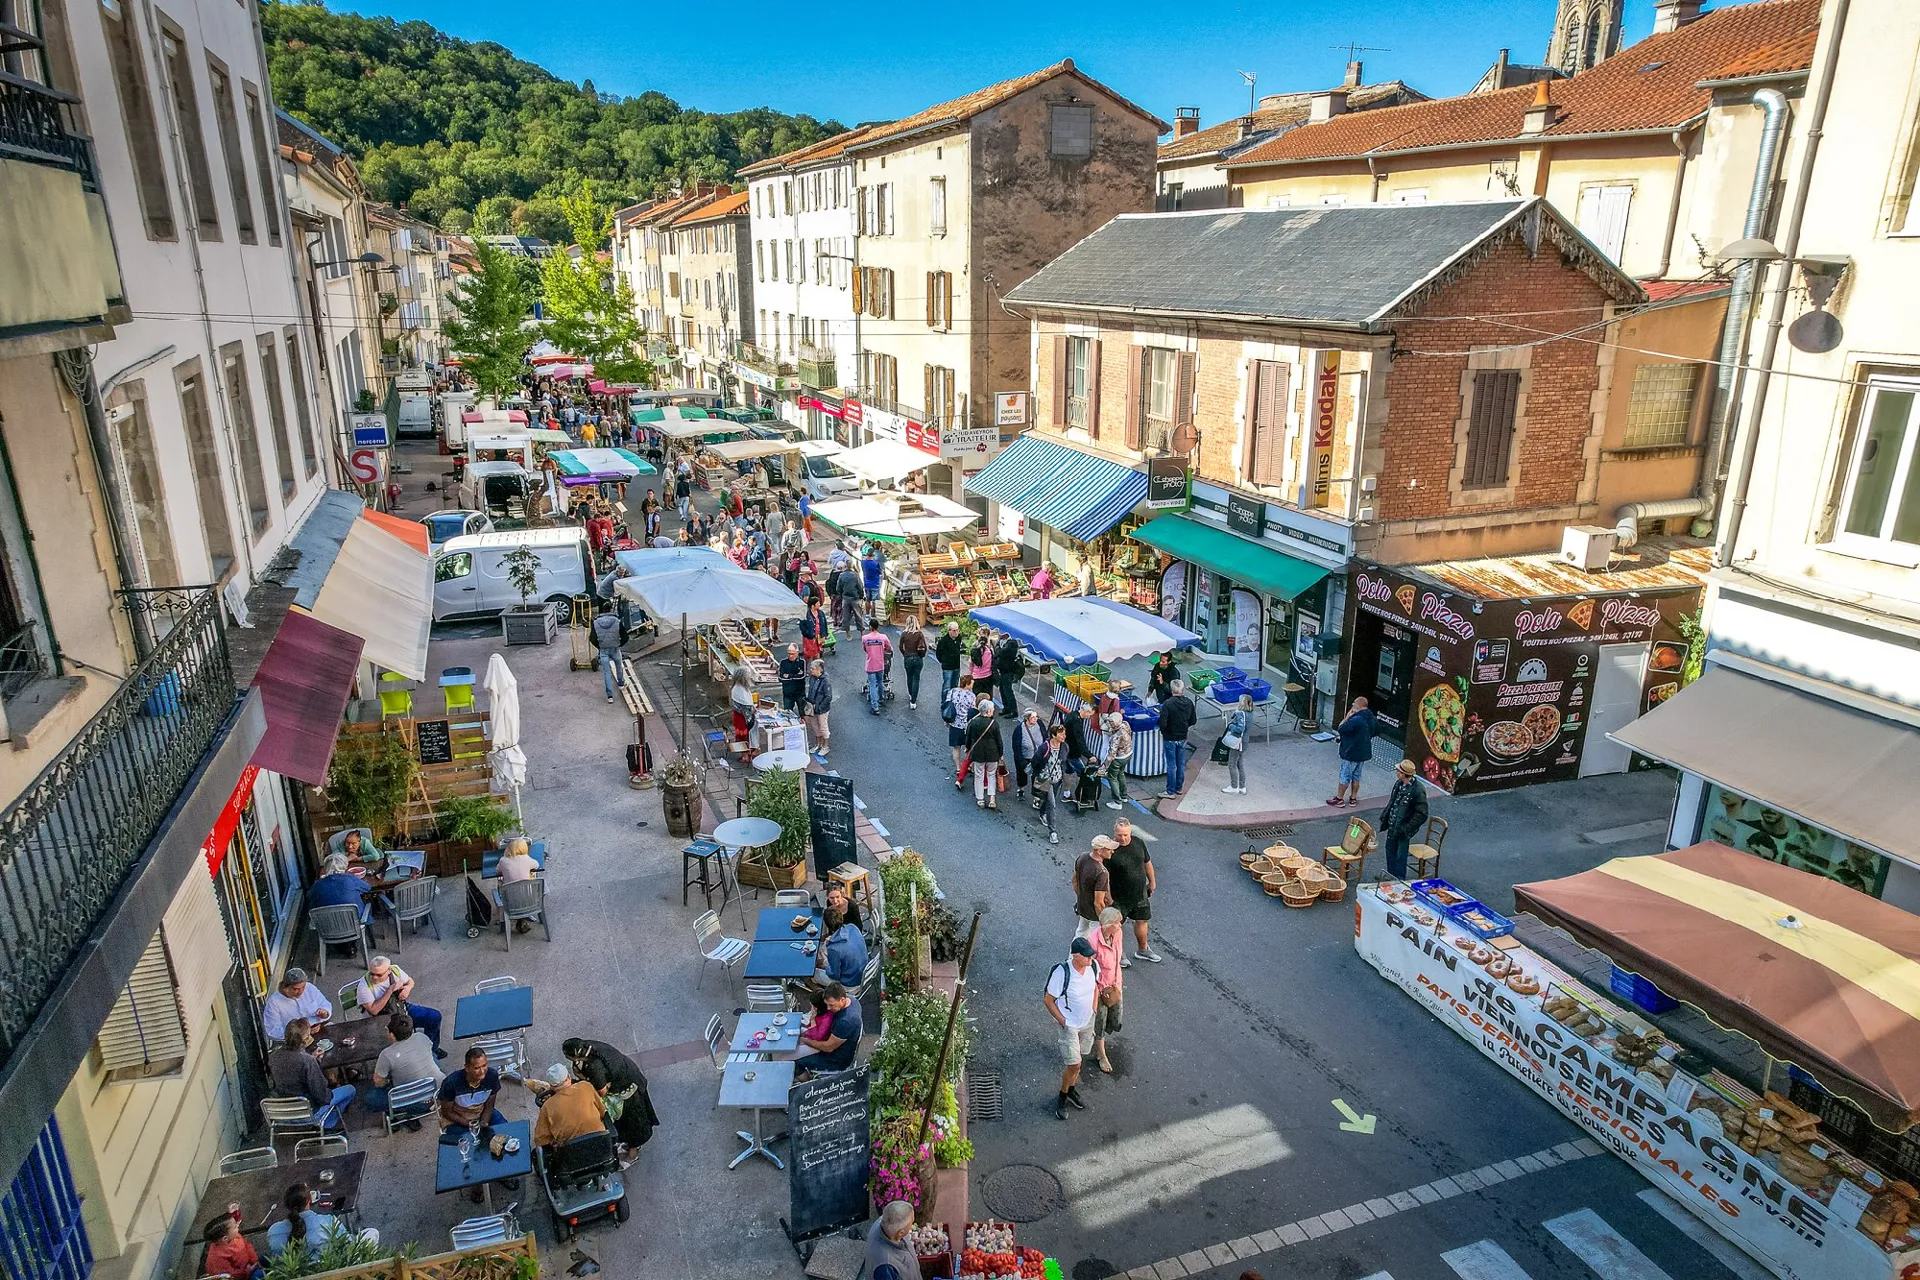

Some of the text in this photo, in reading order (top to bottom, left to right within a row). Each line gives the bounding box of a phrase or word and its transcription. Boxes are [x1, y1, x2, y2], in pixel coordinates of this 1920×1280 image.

[1314, 364, 1337, 448] Kodak
[957, 434, 997, 443] TRAITEUR
[351, 449, 377, 483] S
[1315, 453, 1330, 497] films
[1266, 524, 1282, 532] PHOTO
[1356, 574, 1474, 640] Pola Pizza
[1361, 602, 1380, 616] TOUTES
[1380, 608, 1392, 620] NOS
[1392, 612, 1409, 626] PIZZAS
[1515, 599, 1660, 640] Pola Pizza
[1522, 639, 1549, 647] TOUTES
[1562, 636, 1584, 644] PIZZAS
[1496, 697, 1511, 708] AU
[1511, 696, 1526, 706] FEU
[1526, 695, 1538, 704] DE
[1538, 692, 1560, 703] BOIS
[840, 1079, 856, 1090] jour
[1386, 911, 1458, 972] PAIN
[1474, 977, 1517, 1016] de
[1535, 1023, 1829, 1238] CAMPAGNE
[1464, 984, 1666, 1145] VIENNOISERIES
[1416, 973, 1741, 1218] PATISSERIES REGIONALES
[1482, 1034, 1495, 1053] la
[1556, 1090, 1570, 1113] du
[1572, 1104, 1638, 1160] Rouergue
[1702, 1160, 1824, 1249] au levain
